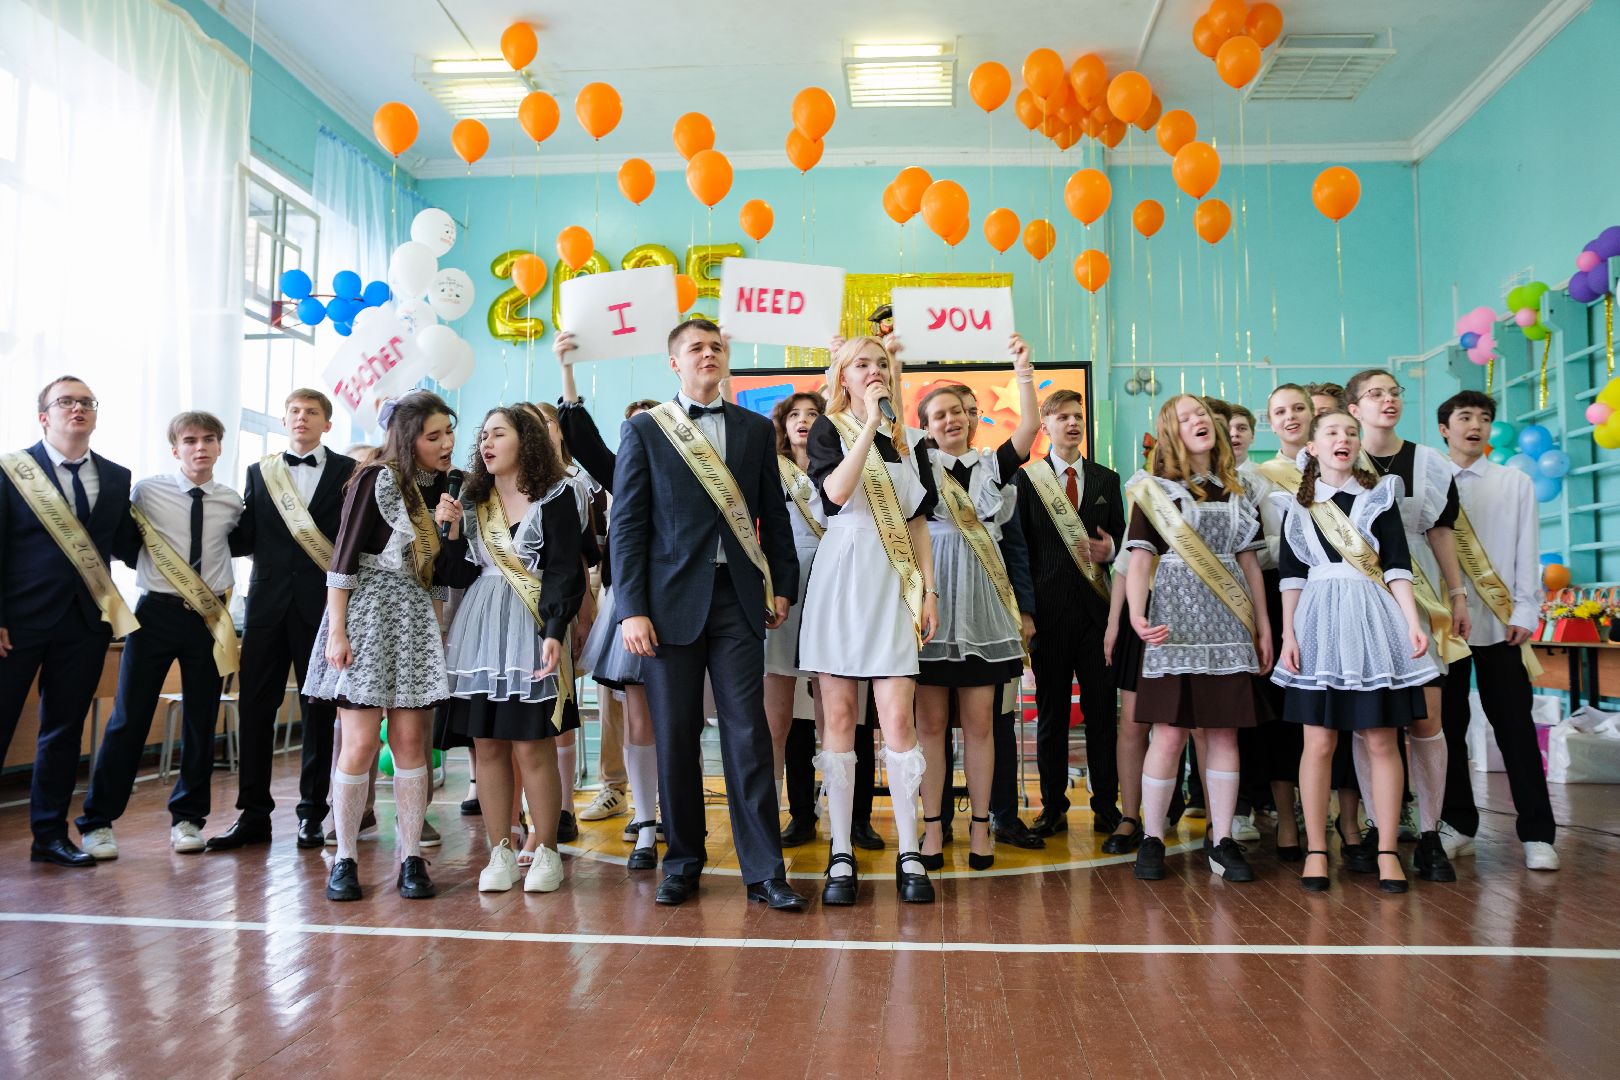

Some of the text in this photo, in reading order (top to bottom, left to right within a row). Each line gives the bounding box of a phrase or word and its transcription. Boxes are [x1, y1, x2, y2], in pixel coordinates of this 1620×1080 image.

[735, 286, 806, 315] NEED
[607, 301, 638, 336] I
[690, 443, 753, 539] Выпускник 2025
[72, 543, 101, 570] 2025
[888, 532, 911, 563] 2025
[189, 587, 217, 611] 2025
[1218, 581, 1248, 607] 2025
